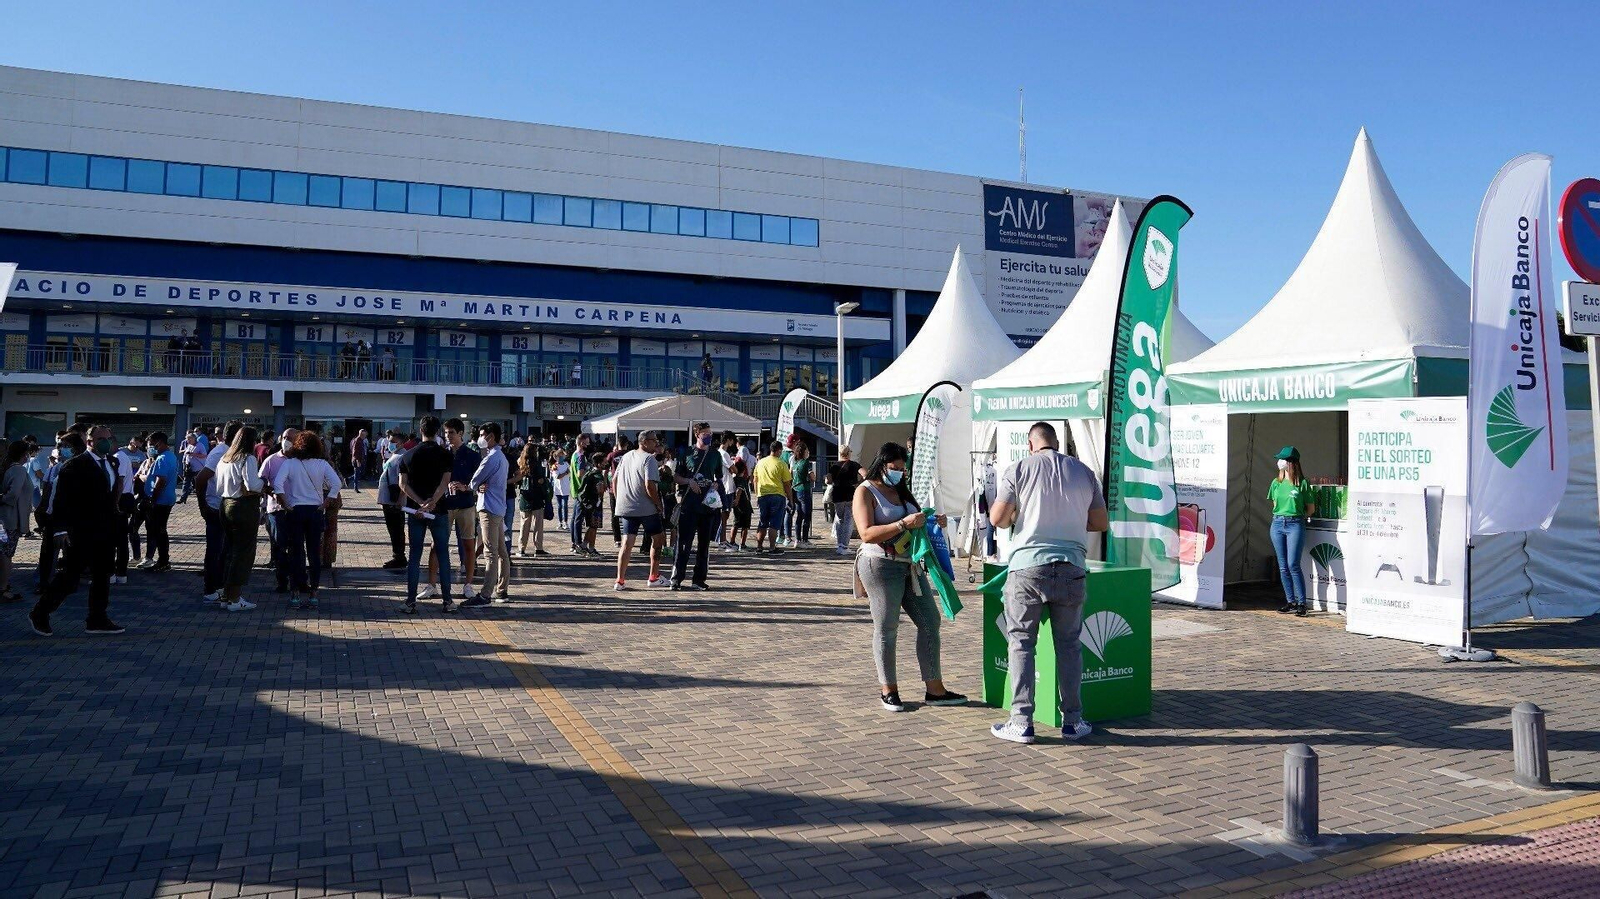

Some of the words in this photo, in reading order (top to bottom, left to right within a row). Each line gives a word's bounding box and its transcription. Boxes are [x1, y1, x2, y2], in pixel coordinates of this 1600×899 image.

[988, 196, 1048, 230] AMS
[1512, 216, 1530, 290] Banco
[1000, 258, 1046, 273] Ejercita
[1049, 264, 1061, 274] tu
[1065, 265, 1090, 276] salu
[14, 278, 91, 295] ACIO
[112, 283, 147, 298] DE
[168, 286, 318, 306] DEPORTES
[336, 296, 402, 310] JOSE
[464, 302, 558, 318] MARTIN
[575, 308, 682, 324] CARPENA
[238, 324, 254, 338] B1
[306, 327, 323, 341] B1
[388, 331, 404, 345] B2
[450, 334, 466, 347] B2
[512, 336, 528, 349] B3
[1509, 296, 1537, 390] Unicaja
[1113, 312, 1132, 414] PROVINCIA
[1219, 377, 1280, 402] UNICAJA
[1284, 372, 1336, 400] BANCO
[988, 398, 1007, 410] TIENDA
[1009, 396, 1035, 410] UNICAJA
[1036, 394, 1078, 409] BALONCESTO
[868, 401, 890, 420] Juega
[1110, 321, 1180, 559] Juega
[1358, 432, 1412, 446] PARTICIPA
[1010, 449, 1019, 461] UN
[1358, 449, 1371, 462] EN
[1375, 449, 1387, 463] EL
[1390, 450, 1432, 463] SORTEO
[1109, 422, 1123, 511] NUESTRA
[1192, 458, 1200, 468] 12
[1358, 466, 1371, 479] DE
[1374, 466, 1395, 480] UNA
[1399, 467, 1419, 481] PS5
[1108, 666, 1133, 677] Banco
